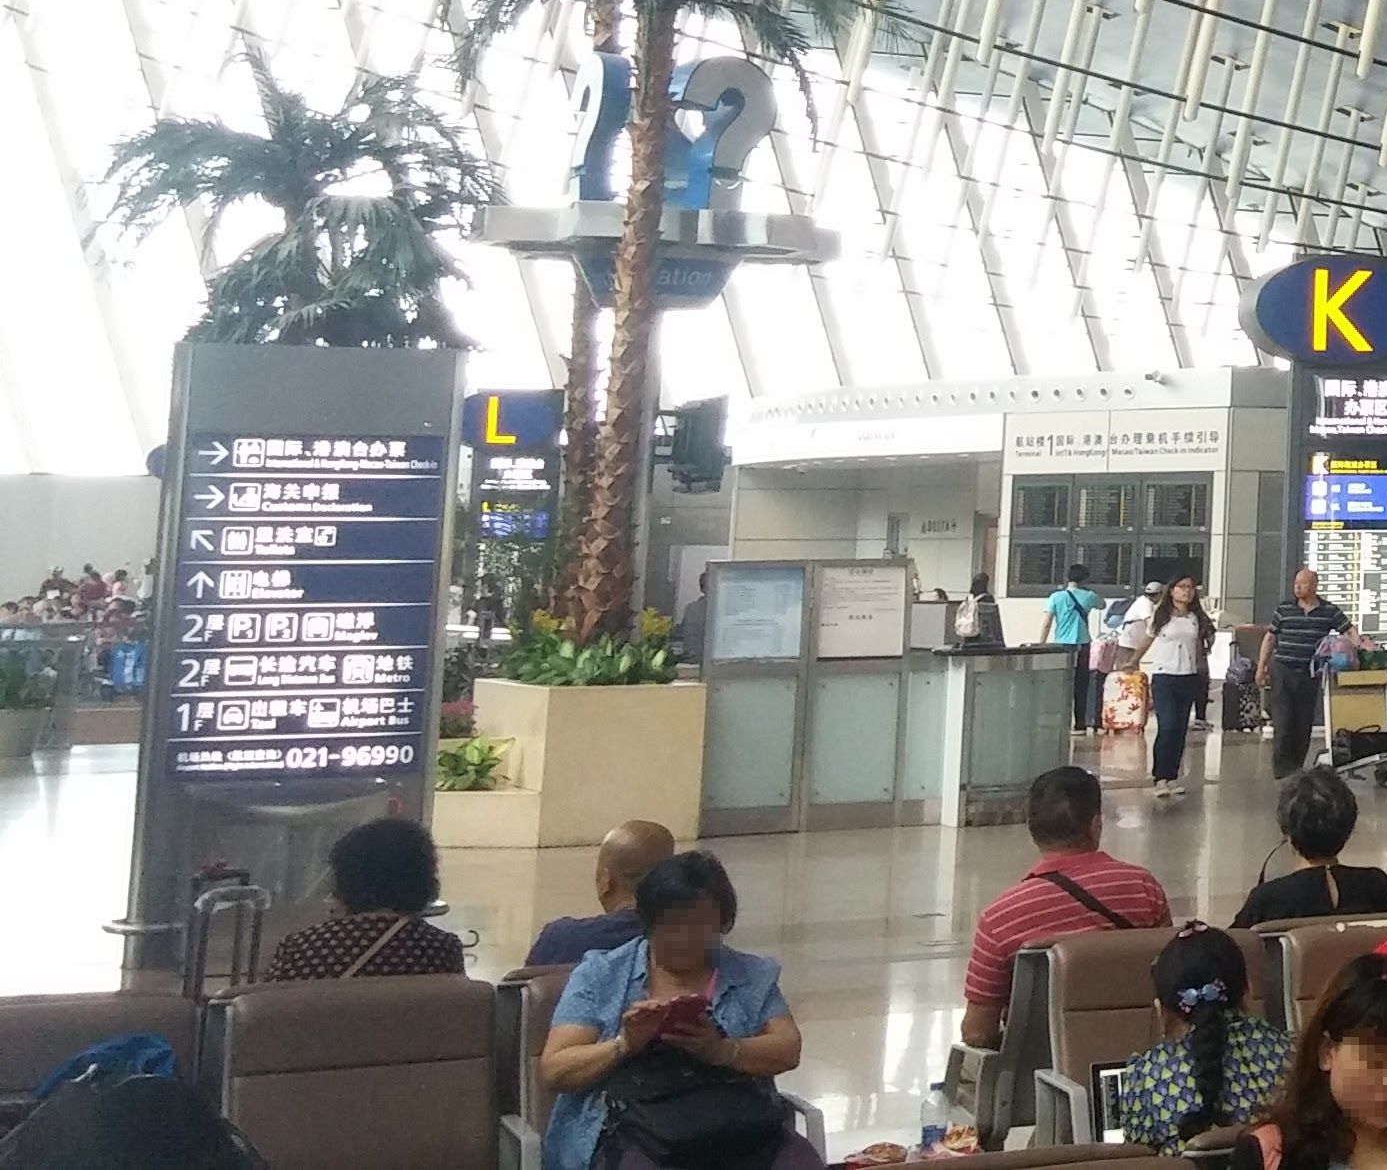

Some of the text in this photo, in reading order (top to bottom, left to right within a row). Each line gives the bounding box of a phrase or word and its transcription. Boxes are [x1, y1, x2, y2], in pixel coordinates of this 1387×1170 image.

[1313, 269, 1373, 351] K
[486, 396, 517, 444] L
[181, 614, 203, 642] 2
[178, 659, 199, 687] 2
[375, 655, 414, 671] 地铁
[374, 673, 410, 683] Metro
[177, 703, 190, 731] 1
[342, 697, 414, 715] 机场巴士
[341, 715, 410, 728] Airport Bus
[286, 745, 414, 769] 021-96990
